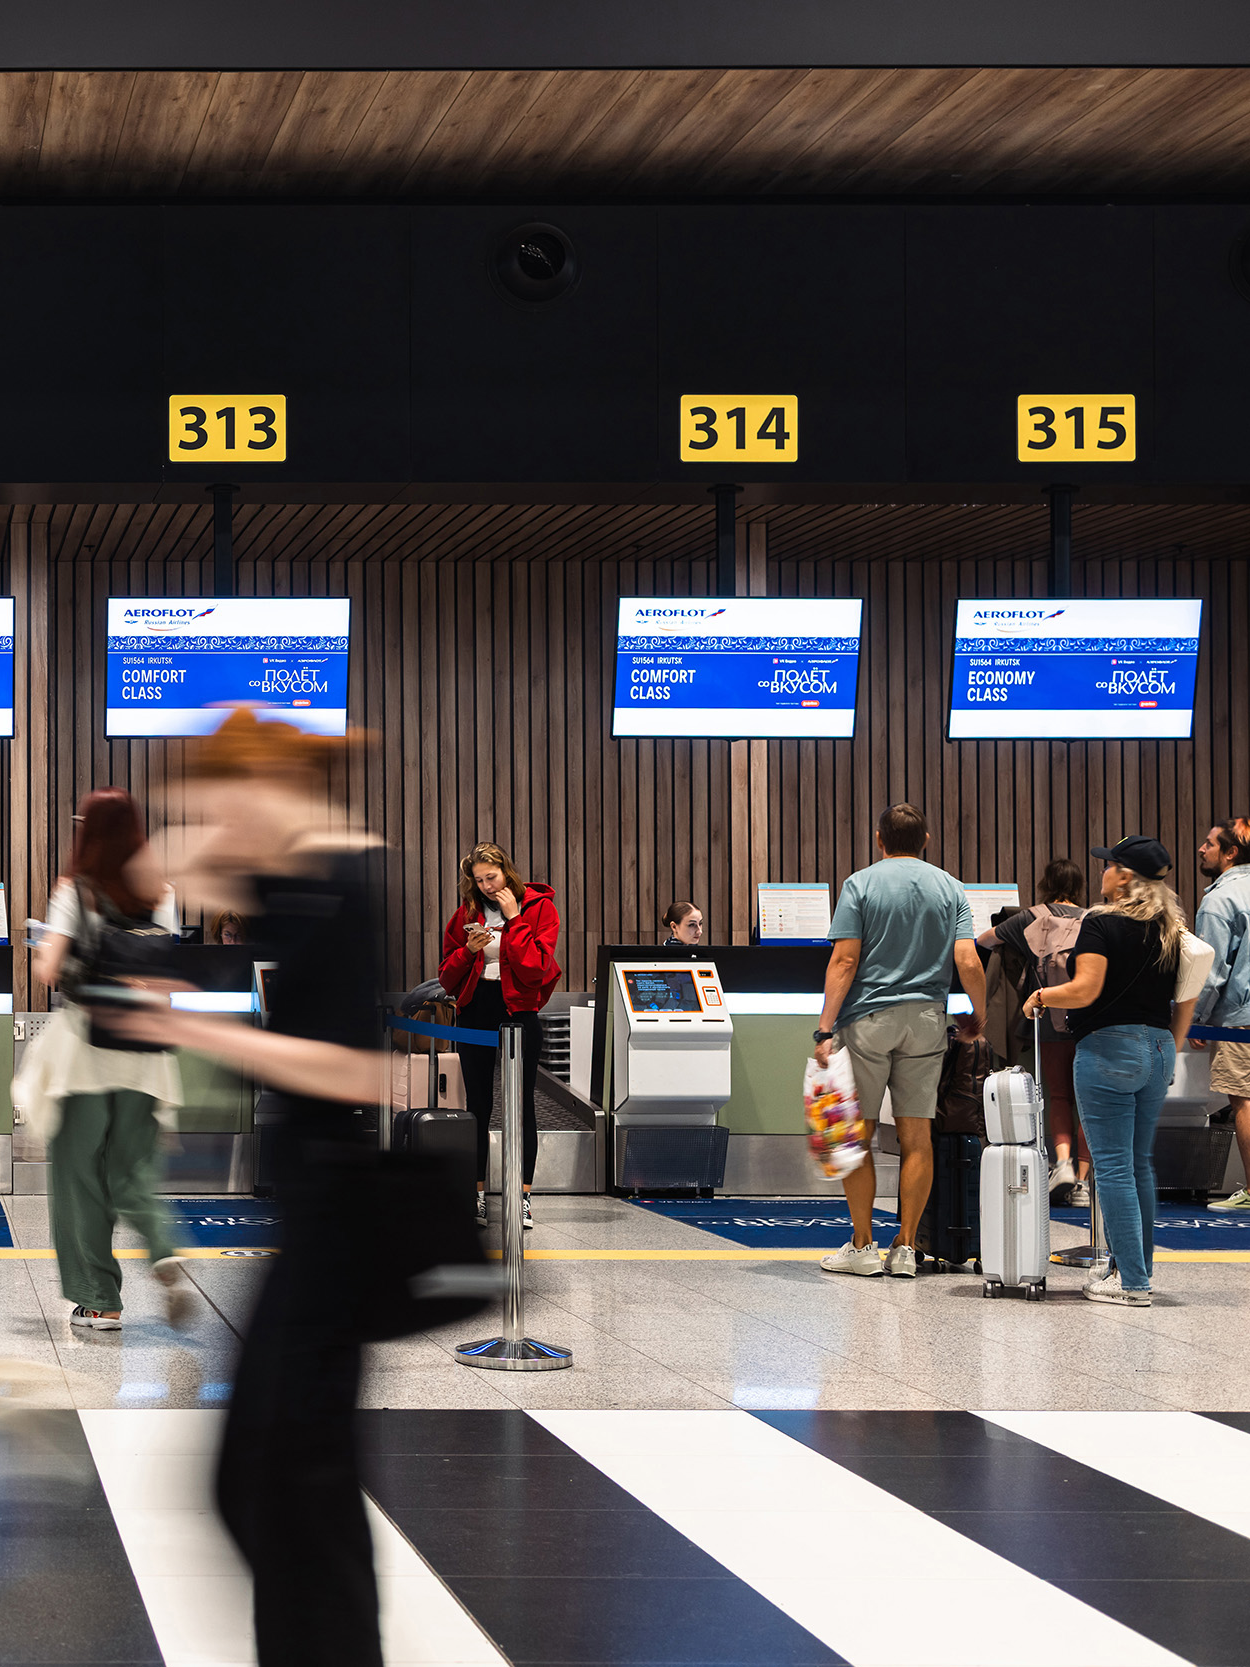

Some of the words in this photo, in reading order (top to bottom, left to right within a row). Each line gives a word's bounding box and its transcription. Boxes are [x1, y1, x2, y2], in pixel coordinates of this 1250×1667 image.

[179, 407, 277, 450] 313
[689, 407, 789, 450] 314
[1028, 407, 1126, 449] 315
[124, 609, 195, 617] AEROFLOT
[636, 609, 706, 617] AEROFLOT
[122, 670, 186, 683] COMFORT
[265, 667, 320, 682] ПОЛЁТ
[631, 670, 696, 683] COMFORT
[774, 667, 830, 682] ПОЛЁТ
[968, 671, 1035, 685] ECONOMY
[1112, 668, 1168, 682] ПОЛЁТ
[122, 686, 162, 699] CLASS
[261, 681, 328, 693] ВКУСОМ
[630, 686, 671, 699] CLASS
[770, 681, 837, 694] ВКУСОМ
[1108, 682, 1175, 694] ВКУСОМ
[967, 688, 1008, 701] CLASS
